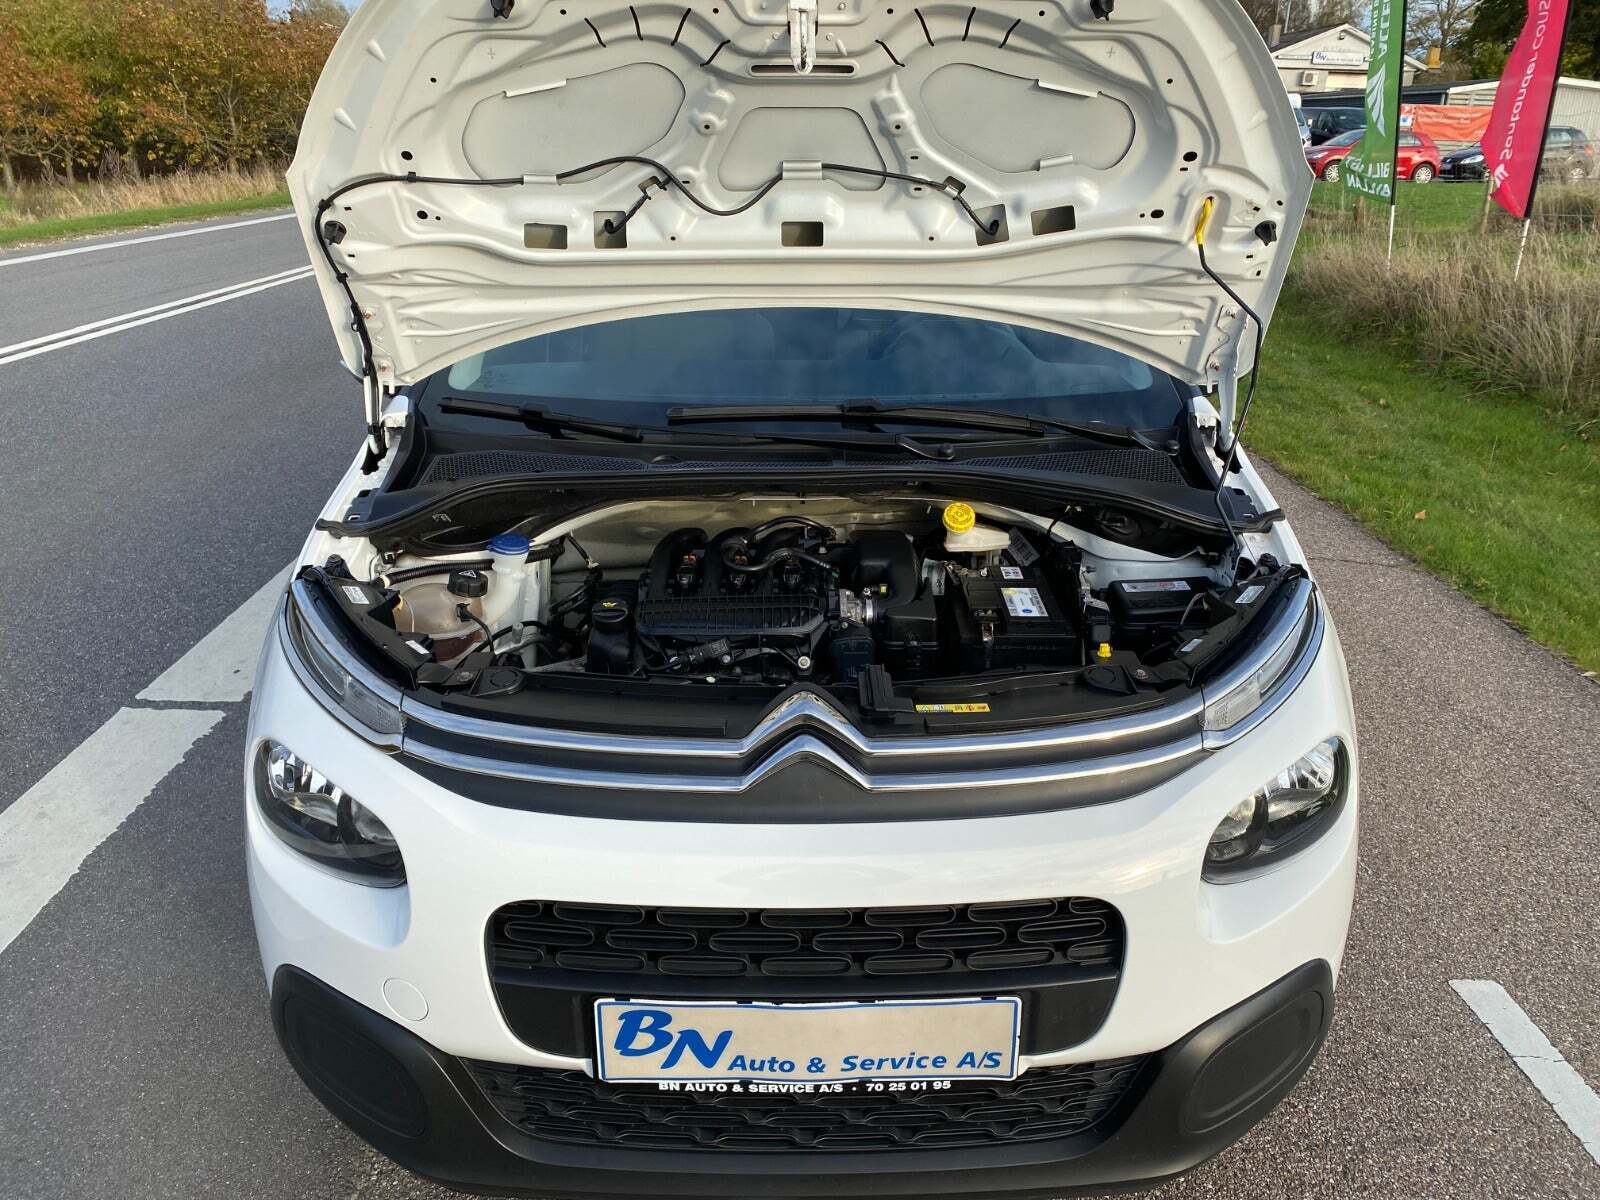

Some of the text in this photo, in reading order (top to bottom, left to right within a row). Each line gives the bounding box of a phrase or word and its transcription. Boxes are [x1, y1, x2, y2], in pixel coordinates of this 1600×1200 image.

[614, 1009, 1003, 1073] BN Auto & Service A/S
[658, 1081, 952, 1093] BN AUTO & SERVICE A/S 70 25 01 95
